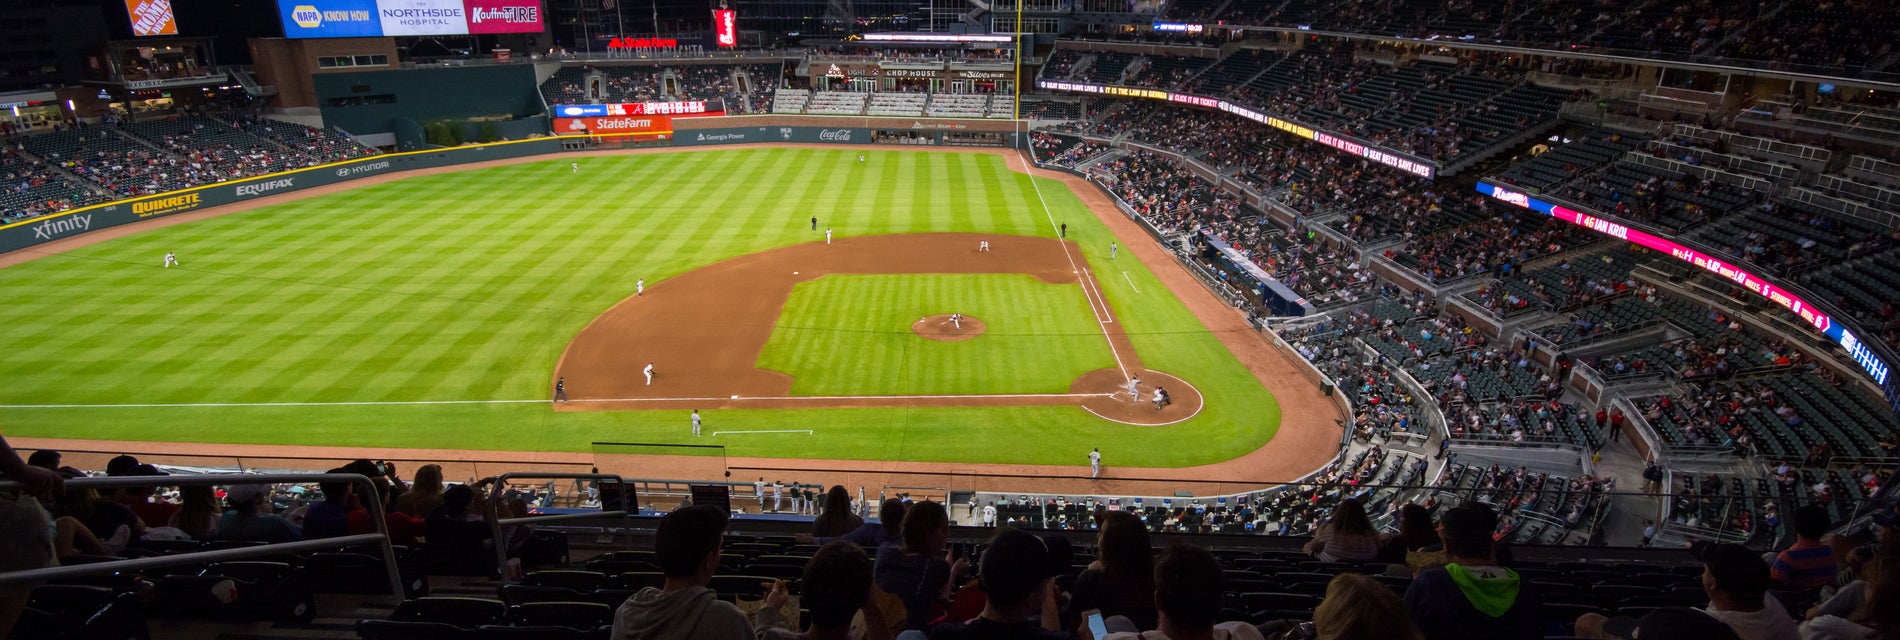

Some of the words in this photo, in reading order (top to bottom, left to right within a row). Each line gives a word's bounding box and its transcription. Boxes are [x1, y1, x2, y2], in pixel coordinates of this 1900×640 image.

[133, 1, 150, 16] THE
[323, 10, 349, 21] KNOW
[350, 10, 370, 21] HOW
[383, 8, 462, 18] NORTHSIDE
[502, 6, 538, 22] TIRE
[151, 10, 174, 34] DEPOT
[296, 11, 319, 22] NAPA
[607, 46, 632, 58] PLAY
[596, 117, 651, 129] StateFarm
[1148, 91, 1167, 99] GEORGIA
[1174, 94, 1187, 102] CLICK
[1193, 97, 1199, 105] OR
[1200, 98, 1218, 107] TICKET!
[1319, 133, 1332, 145] CLICK
[1332, 137, 1338, 147] IT
[1337, 139, 1344, 149] OR
[1344, 141, 1363, 156] TICKET!
[1369, 149, 1382, 161] SEAT
[1382, 153, 1398, 167] BELTS
[1397, 158, 1413, 171] SAVE
[1412, 163, 1430, 177] LIVES
[352, 161, 389, 174] HYUNDAI
[236, 178, 295, 196] EQUIFAX
[132, 193, 200, 213] QUIKRETE
[32, 213, 92, 240] xfinity
[1583, 216, 1595, 228] 46
[1594, 218, 1608, 233] IAN
[1608, 222, 1628, 240] KROL
[1762, 284, 1770, 296] 5
[1770, 291, 1792, 308] STRIKES:
